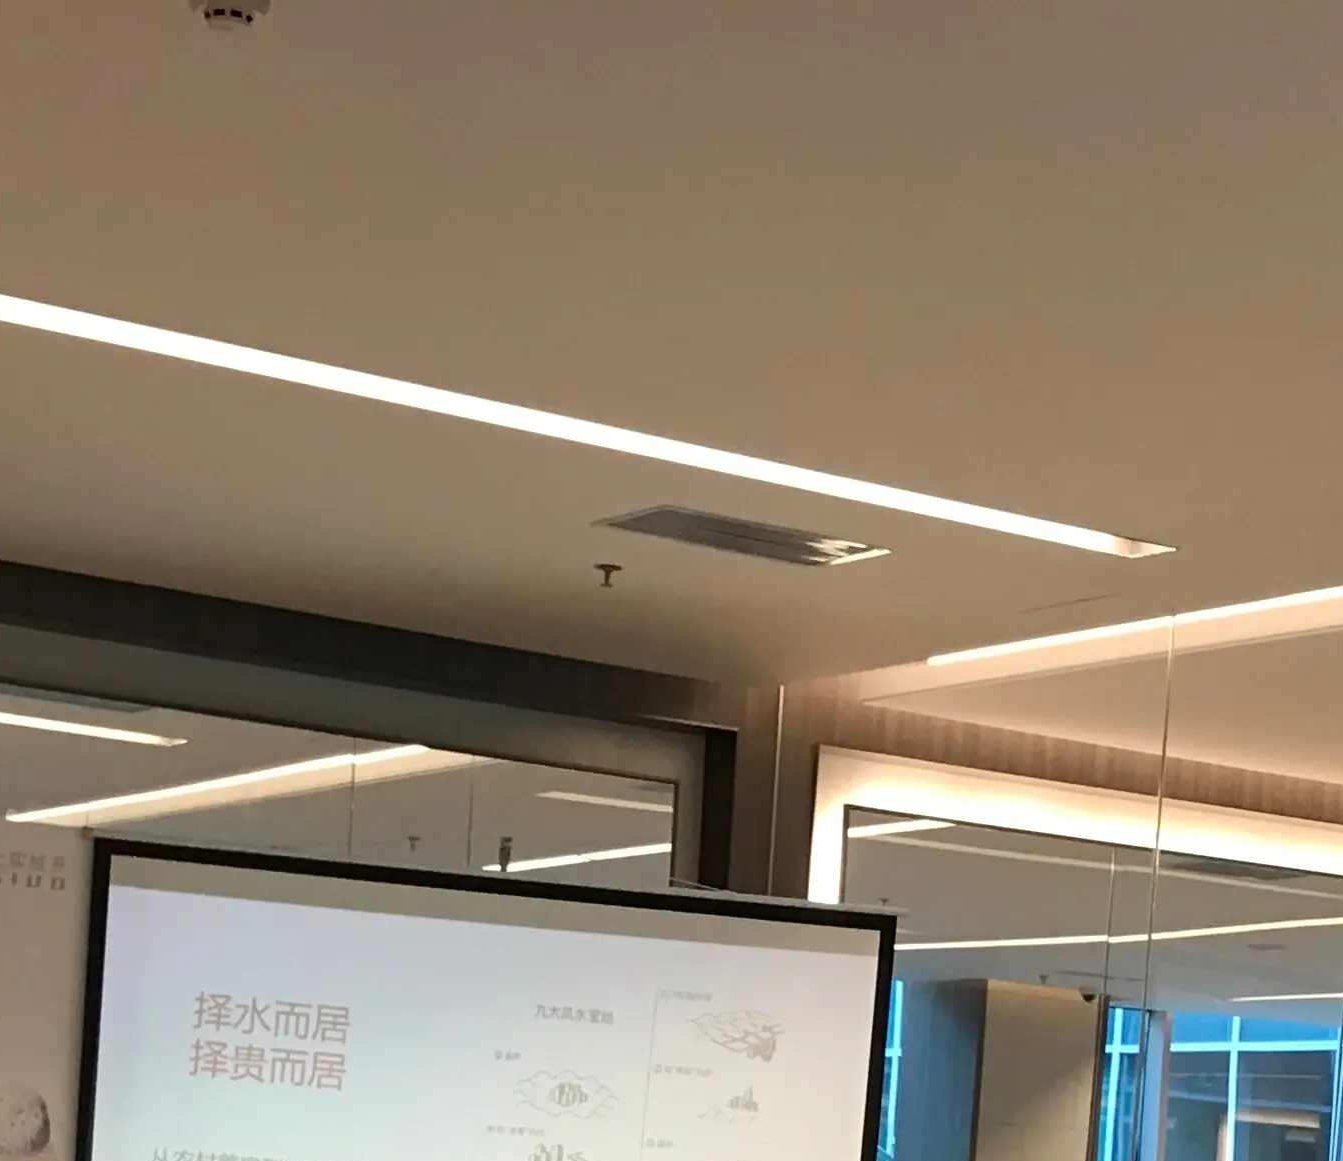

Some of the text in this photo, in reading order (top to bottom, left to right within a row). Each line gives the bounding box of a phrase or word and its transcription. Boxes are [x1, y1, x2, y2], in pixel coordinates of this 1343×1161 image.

[192, 990, 351, 1045] 择水而居
[189, 1038, 347, 1092] 择贵而居
